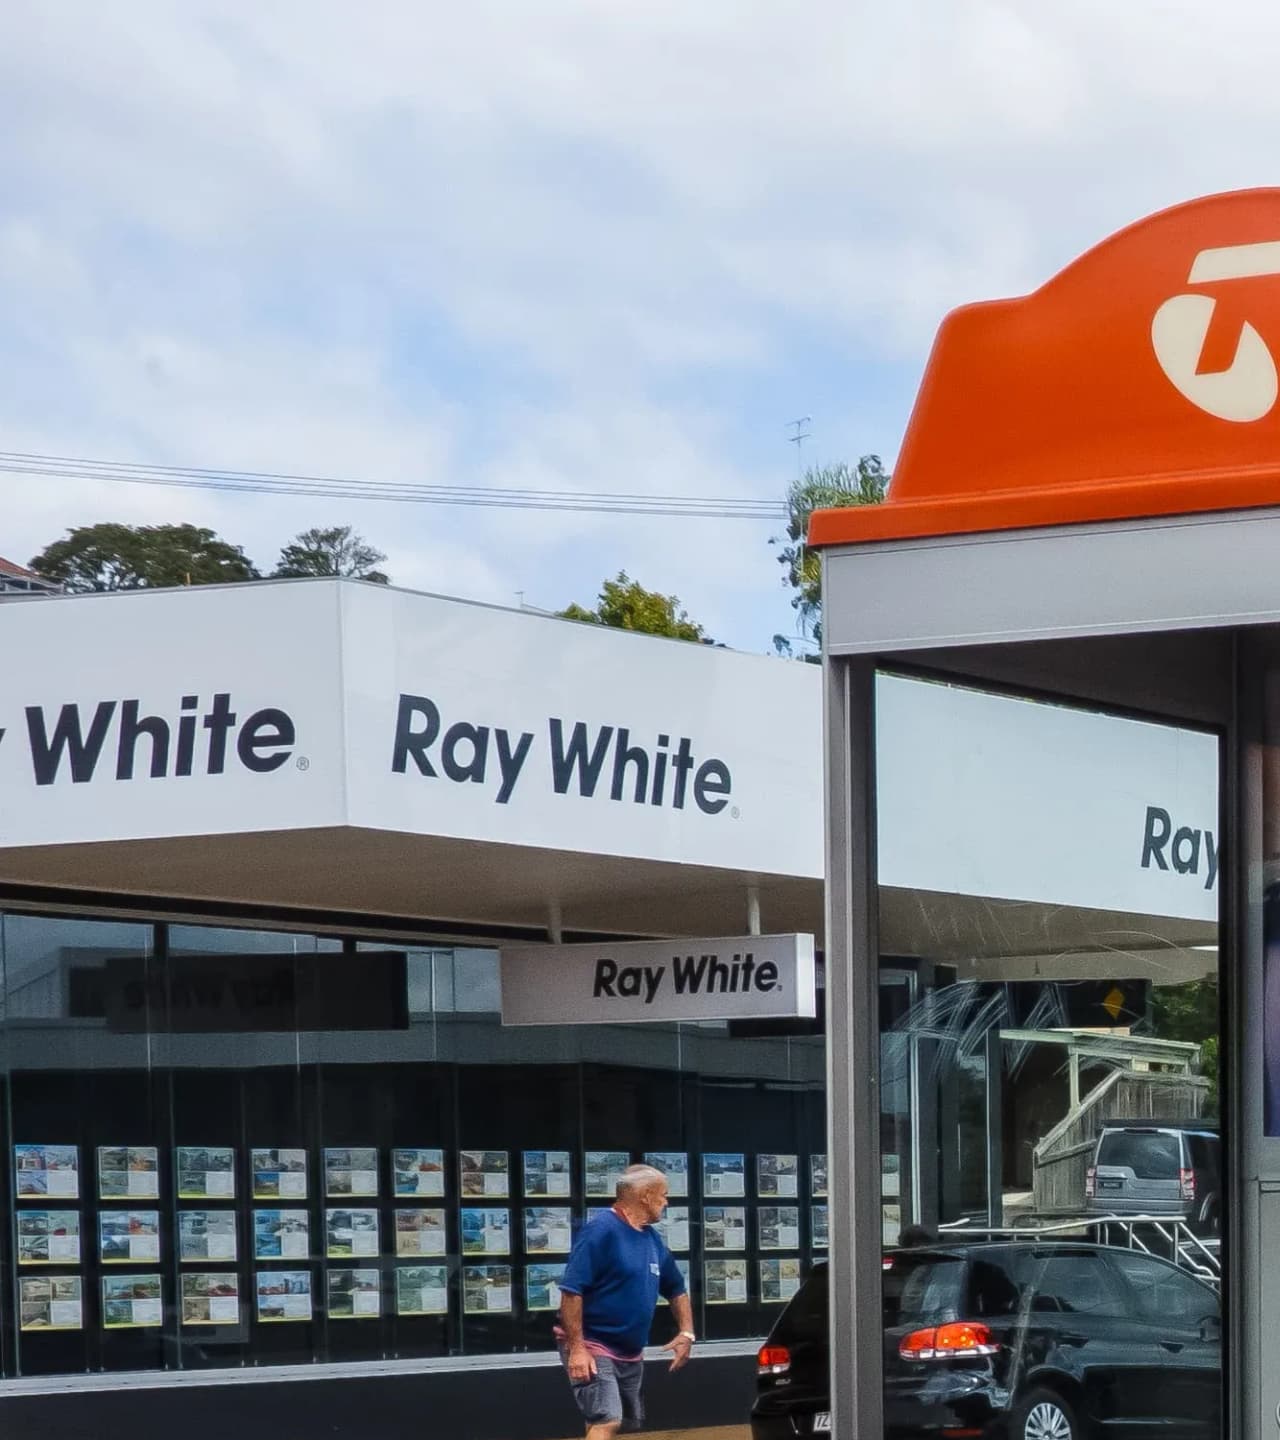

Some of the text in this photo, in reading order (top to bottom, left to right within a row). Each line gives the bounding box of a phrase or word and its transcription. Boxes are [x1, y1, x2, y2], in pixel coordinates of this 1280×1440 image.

[24, 693, 296, 786] White
[391, 693, 733, 815] Ray White
[593, 953, 779, 1004] Ray White
